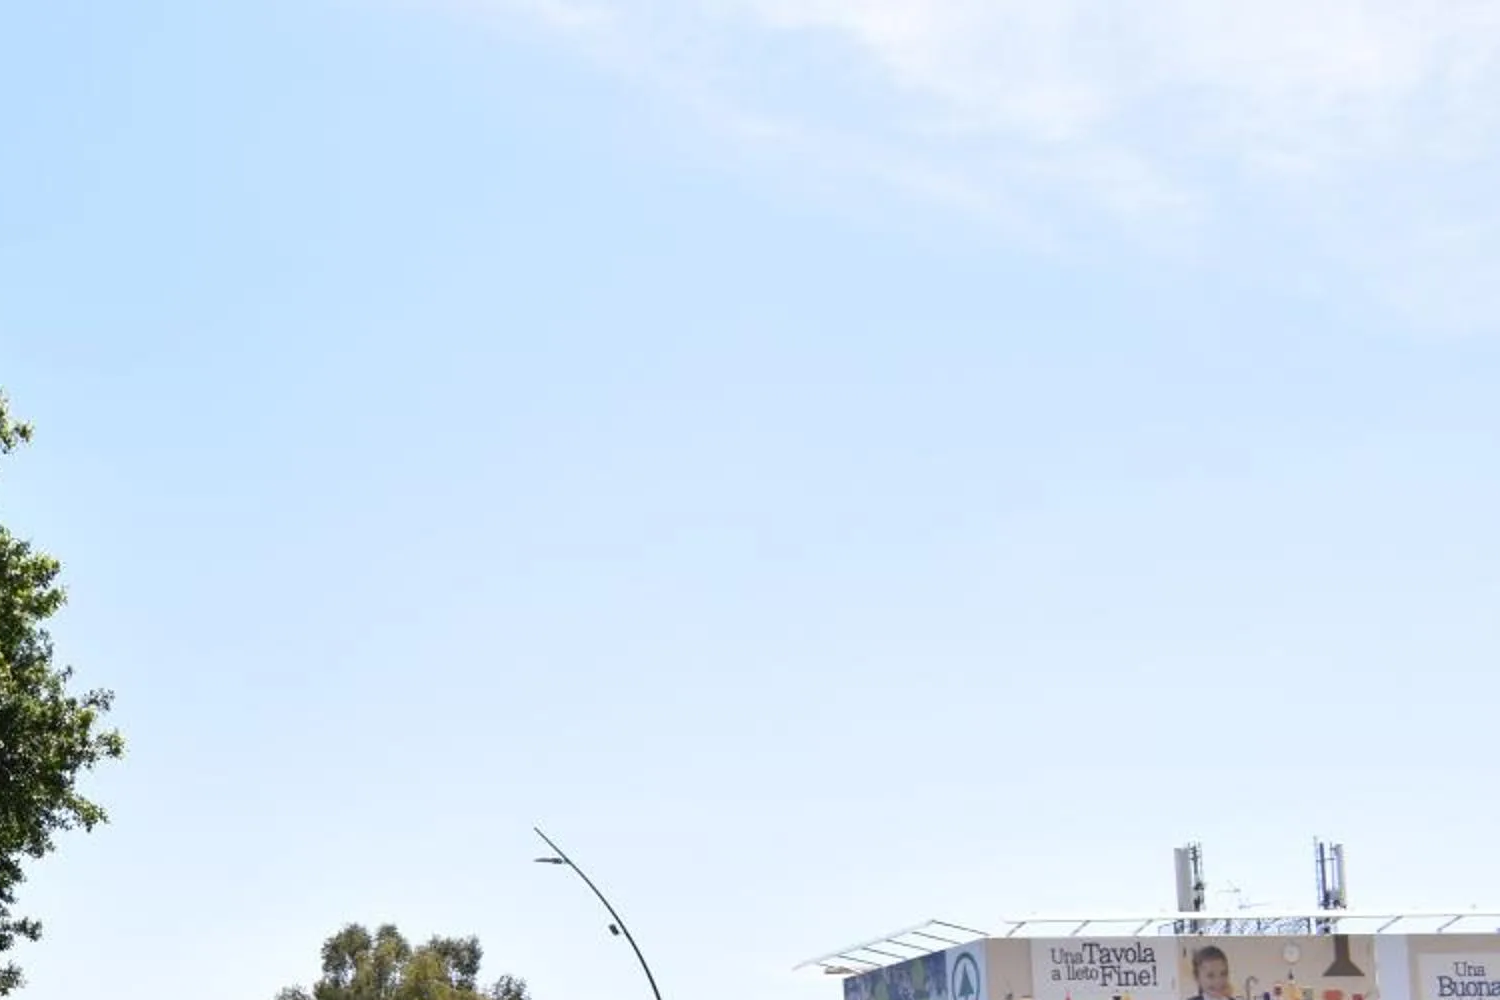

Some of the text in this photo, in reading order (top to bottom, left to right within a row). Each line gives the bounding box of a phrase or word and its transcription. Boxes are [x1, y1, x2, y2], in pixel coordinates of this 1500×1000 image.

[1051, 942, 1156, 965] Una Tavola
[1051, 968, 1062, 981] a
[1099, 965, 1158, 986] Fine!
[1453, 961, 1486, 977] Una
[1436, 975, 1500, 997] Buona
